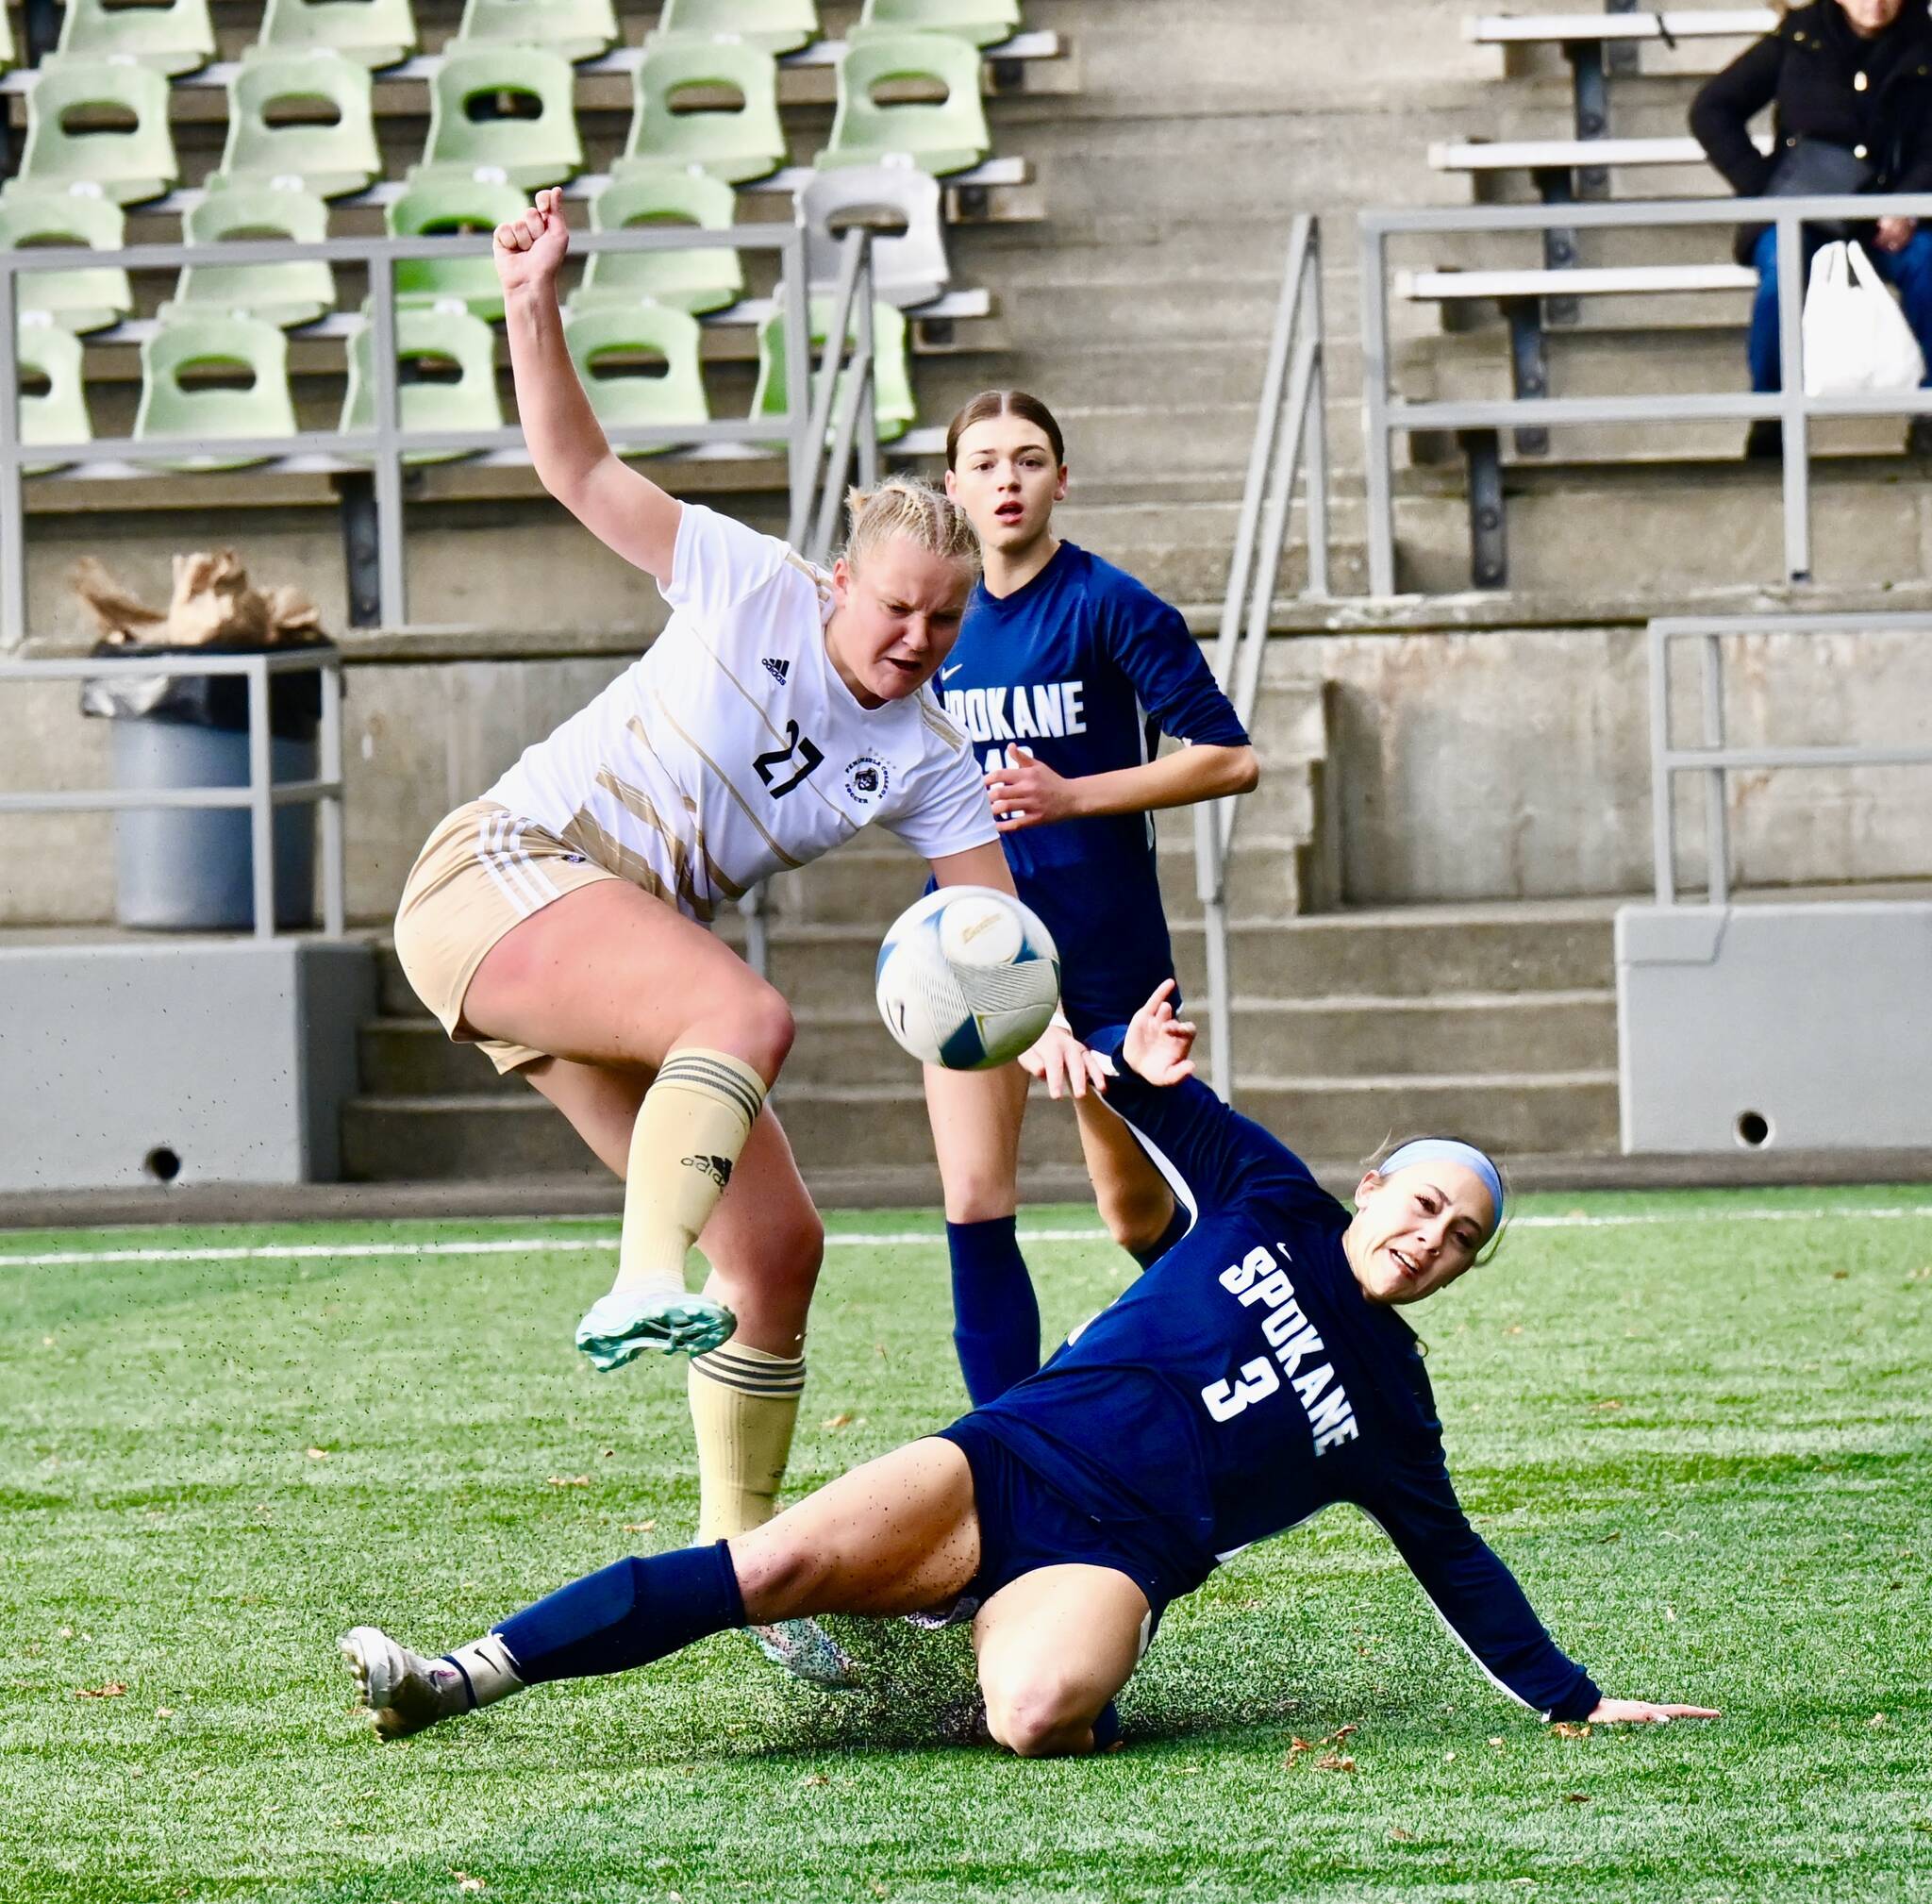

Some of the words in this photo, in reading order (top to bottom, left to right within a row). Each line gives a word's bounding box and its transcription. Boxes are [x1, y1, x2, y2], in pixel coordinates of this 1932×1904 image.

[761, 658, 787, 686] adidas
[944, 681, 1087, 743] POKANE
[752, 719, 825, 800] 27
[844, 783, 869, 804] SOCCER
[680, 1157, 725, 1194] adid
[1218, 1245, 1359, 1457] SPOKANE
[1201, 1356, 1280, 1423] 3
